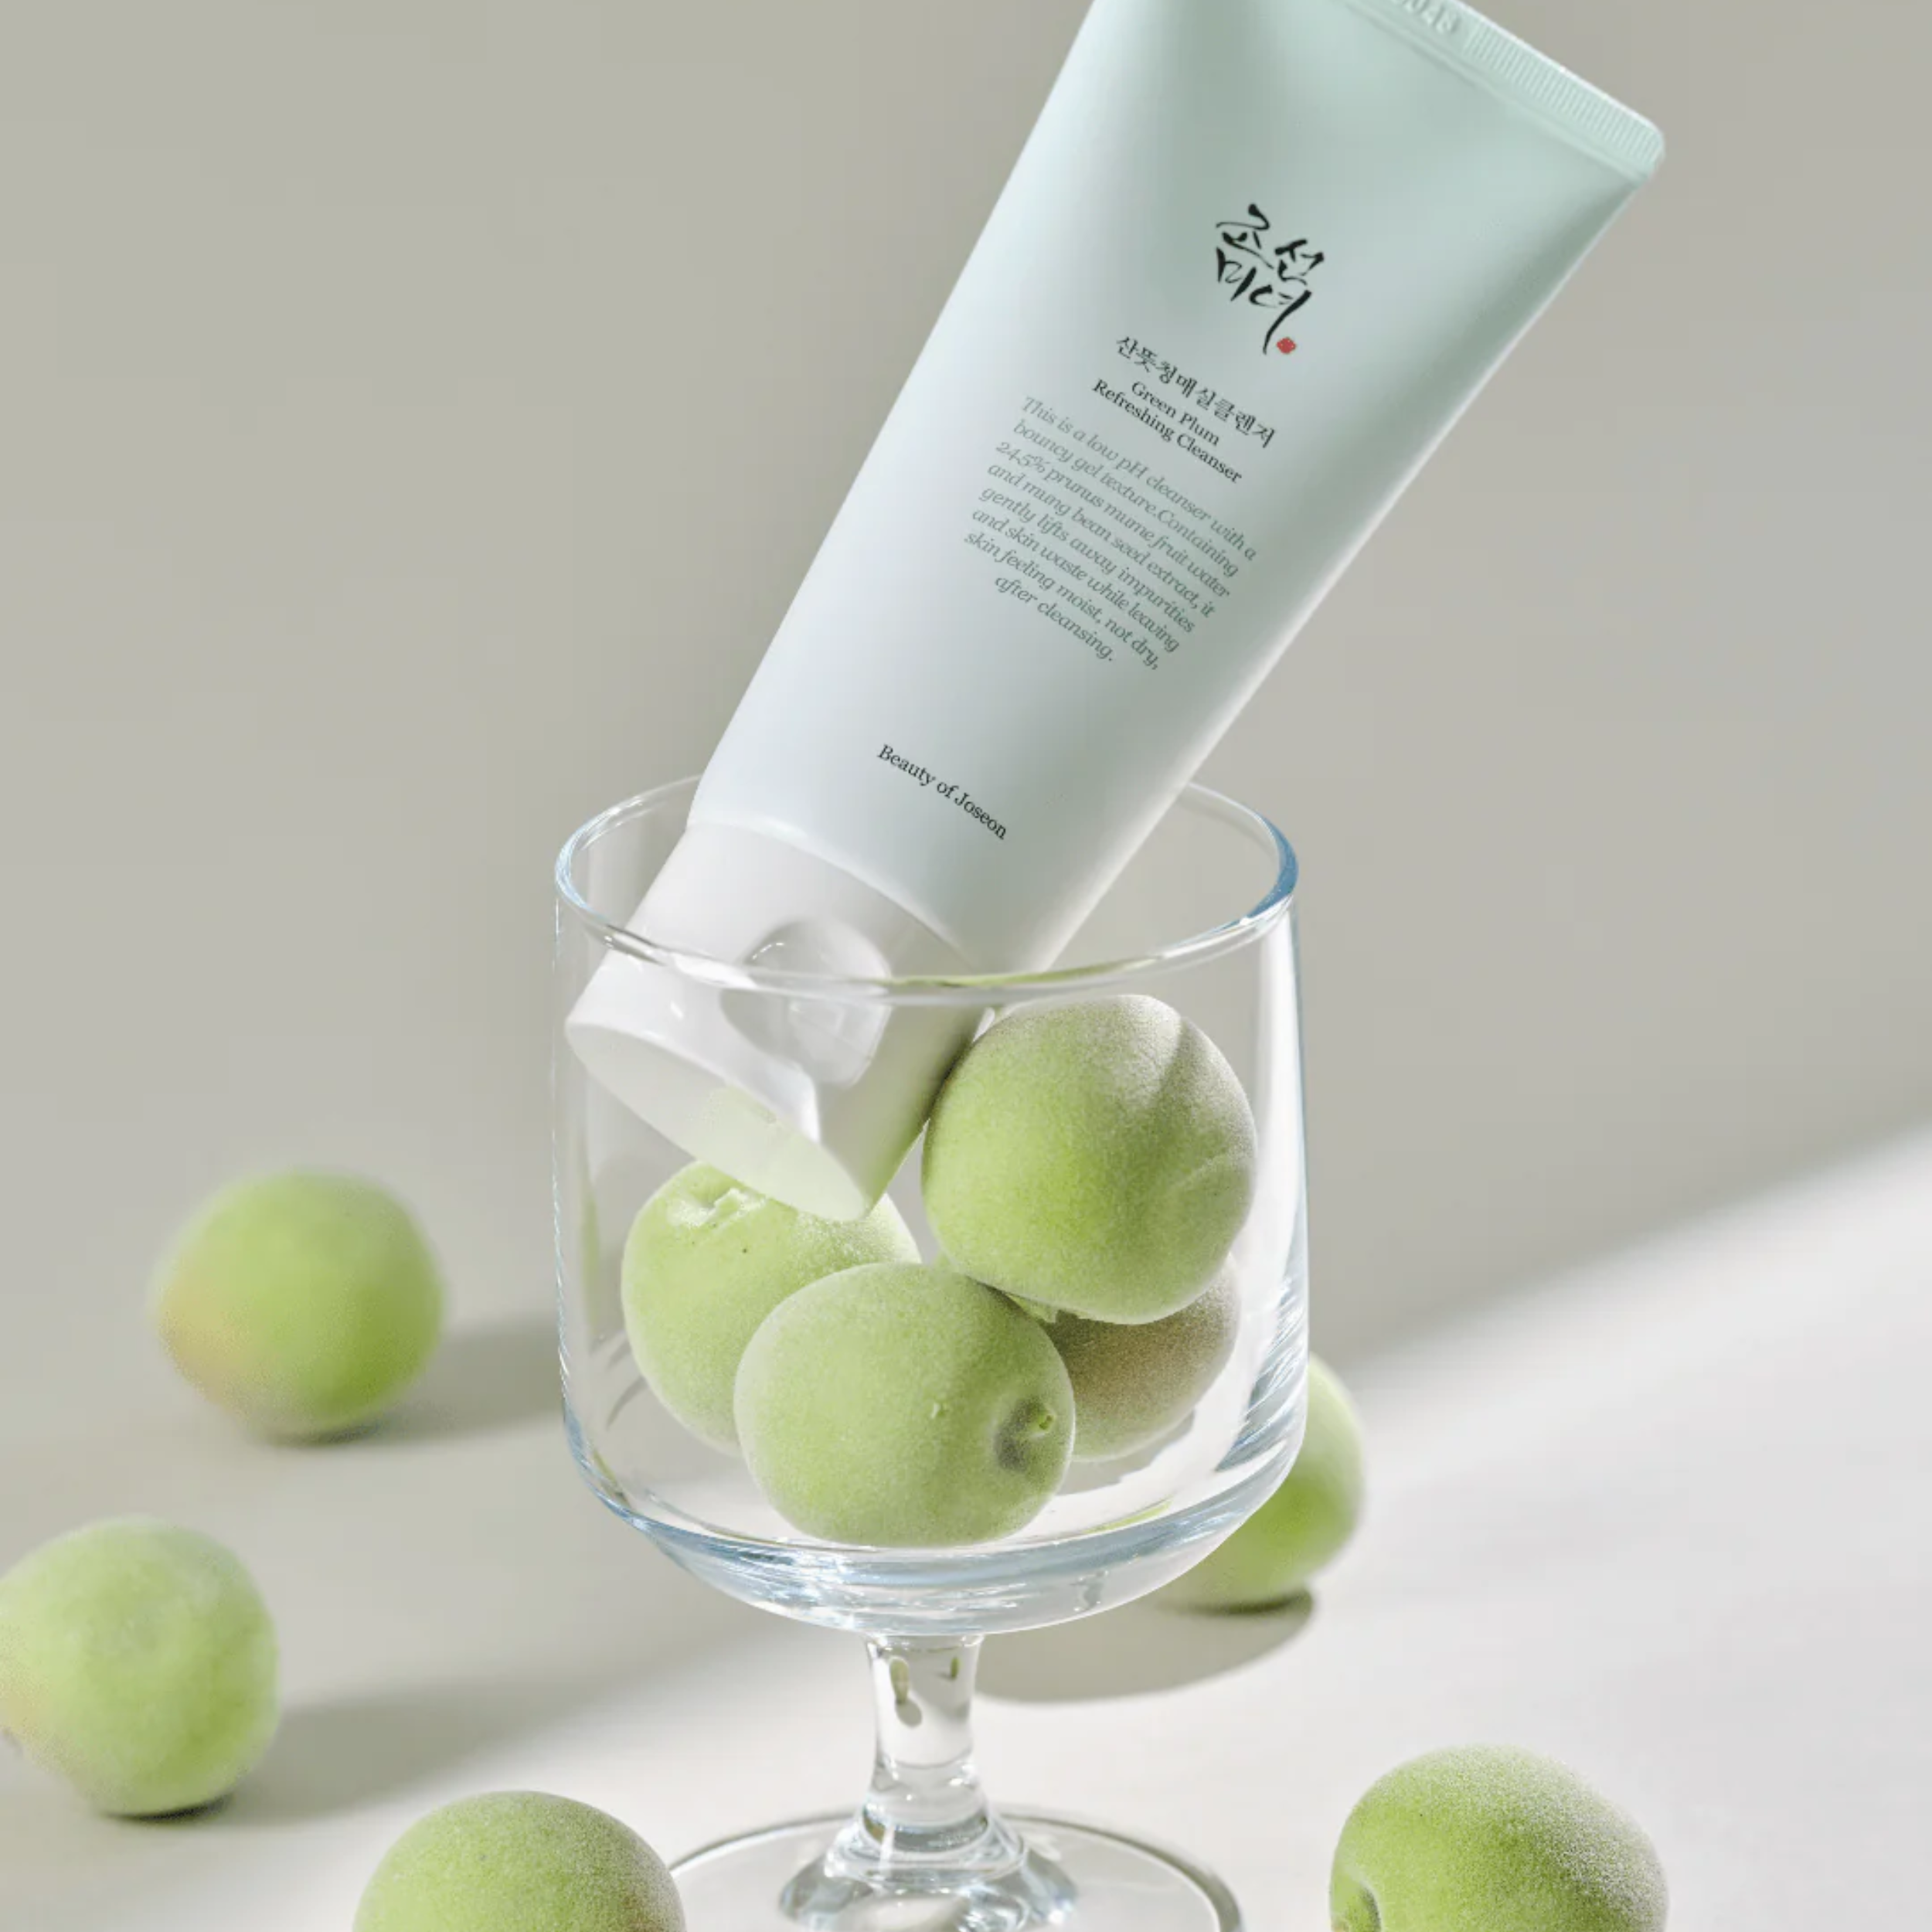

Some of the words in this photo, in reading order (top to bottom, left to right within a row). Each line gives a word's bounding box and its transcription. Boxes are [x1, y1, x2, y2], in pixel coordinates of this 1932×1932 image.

[1014, 419, 1074, 462] bouncy
[1071, 456, 1104, 478] gel
[1092, 379, 1175, 444] Refreshing
[1176, 433, 1242, 483] Cleanser
[1131, 381, 1177, 419] Green
[1179, 411, 1219, 446] Plum
[988, 464, 1026, 488] and
[1022, 481, 1070, 516] mung
[1072, 507, 1111, 541] bean
[1111, 537, 1151, 566] seed
[1147, 561, 1199, 610] extract,
[1199, 601, 1216, 617] it
[1022, 396, 1057, 424] This
[1057, 417, 1073, 434] is
[1073, 430, 1085, 441] a
[1087, 434, 1119, 461] low
[1117, 457, 1149, 479] pH
[1146, 476, 1212, 522] cleanser
[1211, 519, 1245, 549] with
[1245, 548, 1257, 562] a
[1043, 470, 1104, 509] prunus
[1104, 502, 1155, 541] mume
[1148, 535, 1189, 566] fruit
[1188, 560, 1230, 598] water
[964, 532, 1001, 554] skin
[995, 549, 1055, 590] feeling
[1056, 585, 1103, 624] moist,
[1105, 617, 1131, 642] not
[1131, 637, 1159, 669] dry,
[972, 510, 1009, 532] and
[1005, 526, 1039, 553] skin
[1041, 545, 1087, 580] waste
[1087, 577, 1128, 610] while
[1128, 602, 1179, 653] leaving
[978, 488, 1036, 523] gently
[1037, 514, 1070, 539] lifts
[1070, 538, 1117, 575] away
[1118, 567, 1195, 633] impurities
[995, 577, 1038, 604] after
[1038, 601, 1114, 662] cleansing.
[877, 743, 937, 787] Beauty
[936, 781, 959, 799] of
[954, 792, 1007, 840] Joseon
